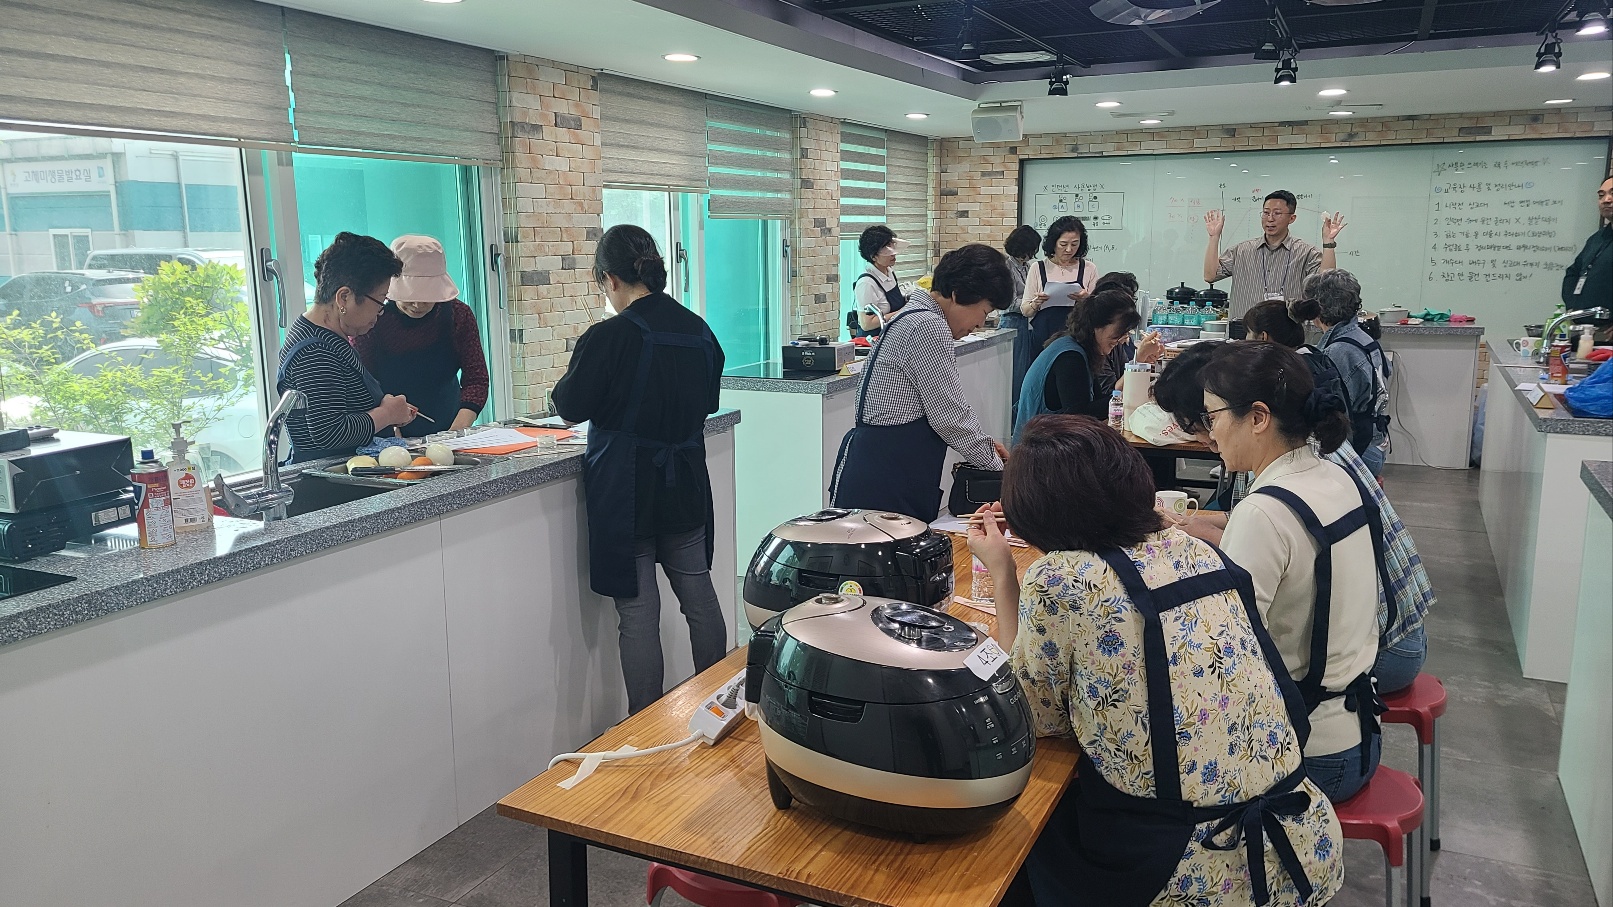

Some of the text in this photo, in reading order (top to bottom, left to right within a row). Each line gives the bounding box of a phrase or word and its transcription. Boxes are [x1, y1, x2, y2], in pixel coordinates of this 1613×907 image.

[23, 168, 92, 184] 고체미생물발효실
[1051, 184, 1069, 193] 인덕션
[1444, 182, 1466, 194] 교육장
[1469, 182, 1483, 193] 사용
[1467, 271, 1480, 282] 물건
[1483, 272, 1511, 283] 건드리지
